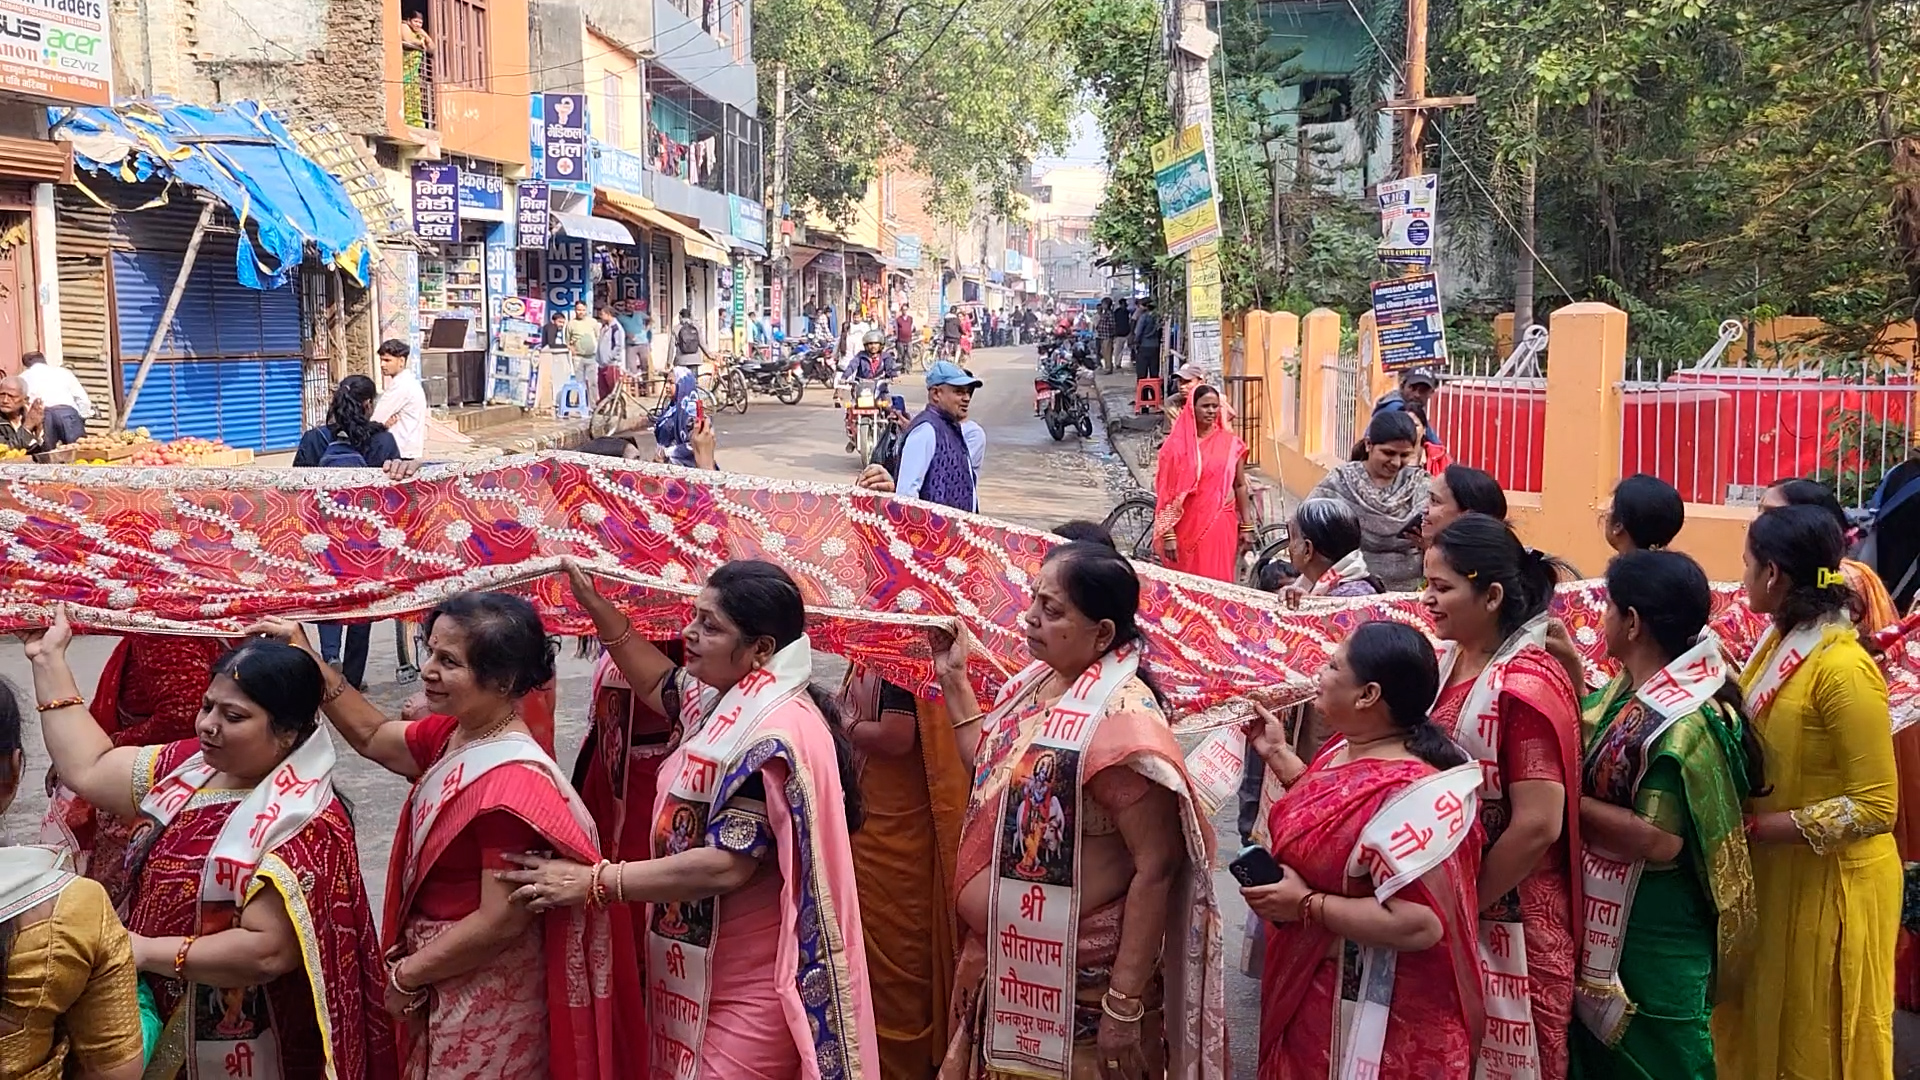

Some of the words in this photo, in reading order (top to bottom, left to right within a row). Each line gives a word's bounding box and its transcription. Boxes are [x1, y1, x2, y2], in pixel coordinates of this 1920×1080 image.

[0, 15, 41, 42] US
[46, 28, 101, 56] acer
[61, 56, 99, 73] EZVIZ
[1407, 280, 1433, 291] OPEN
[1073, 661, 1102, 700] गौ
[707, 706, 742, 745] गौ
[1043, 708, 1091, 741] माता
[681, 753, 718, 795] माता
[1433, 790, 1465, 840] जय
[1388, 821, 1434, 861] गौ
[1020, 884, 1046, 922] श्री
[1000, 923, 1063, 968] सीताराम
[1489, 923, 1511, 959] श्री
[665, 943, 686, 980] श्री
[999, 967, 1062, 1014] गौशाला
[995, 1010, 1034, 1034] जनकपुर
[225, 1041, 254, 1078] श्री
[1015, 1029, 1041, 1055] नेपाल
